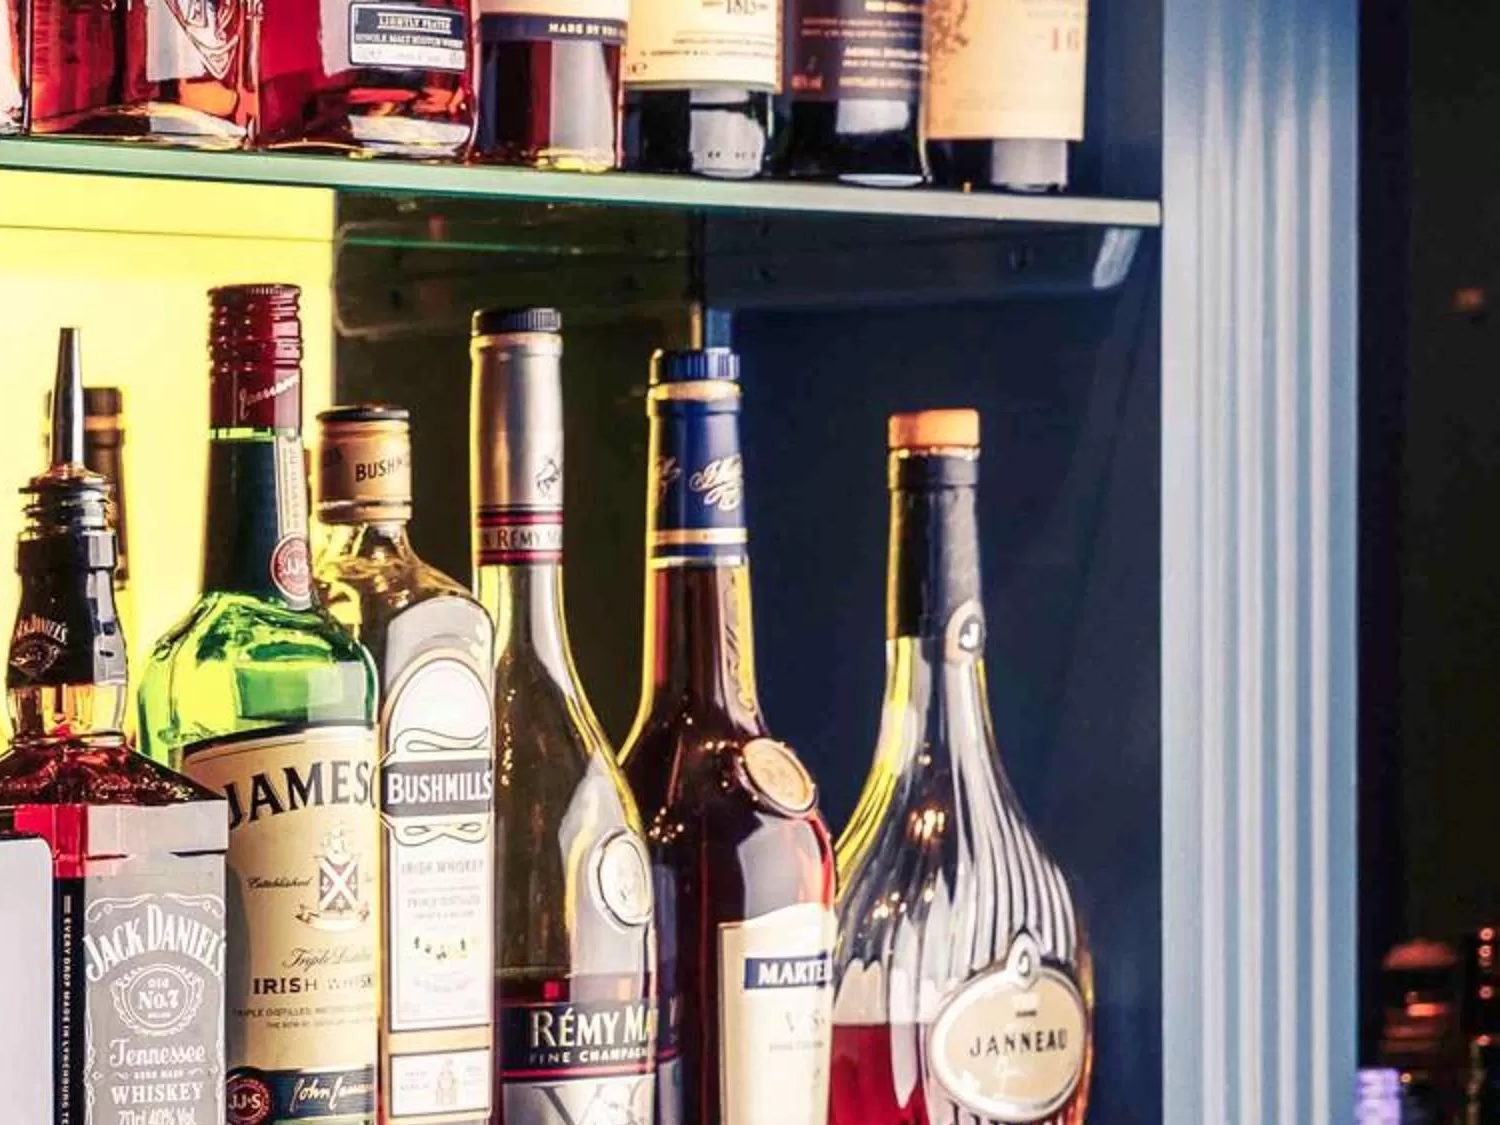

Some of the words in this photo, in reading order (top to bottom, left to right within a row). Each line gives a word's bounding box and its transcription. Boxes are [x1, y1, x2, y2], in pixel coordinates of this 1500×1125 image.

[387, 770, 493, 806] BUSHMILLS
[83, 917, 145, 983] JACK
[252, 976, 318, 996] IRISH
[530, 1005, 621, 1049] RÉMY
[108, 1038, 206, 1069] Tennessee
[529, 1050, 571, 1065] FINE
[969, 1028, 1068, 1058] JANNEAU
[111, 1082, 204, 1105] WHISKEY
